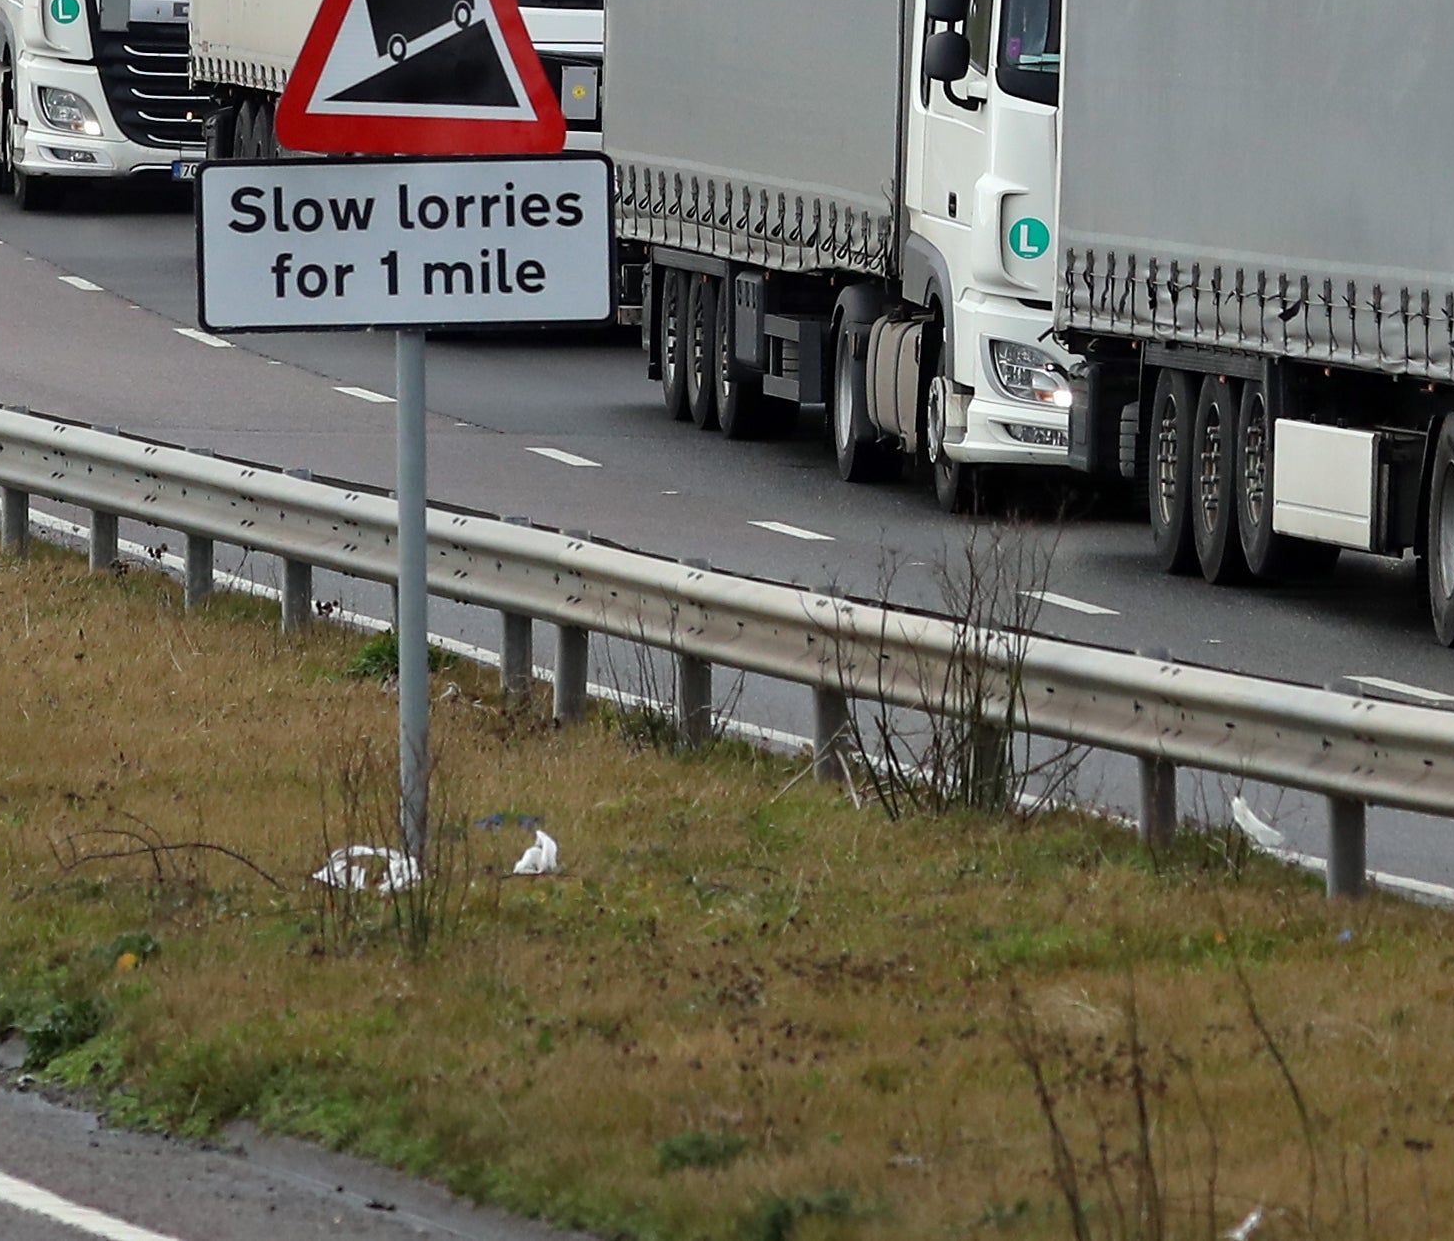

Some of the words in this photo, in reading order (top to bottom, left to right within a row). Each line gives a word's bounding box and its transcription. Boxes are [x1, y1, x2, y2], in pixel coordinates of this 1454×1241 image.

[228, 186, 375, 233] Slow
[398, 182, 584, 230] lorries
[1019, 224, 1039, 253] L
[271, 253, 354, 298] for
[380, 250, 399, 295] 1
[423, 249, 546, 295] mile
